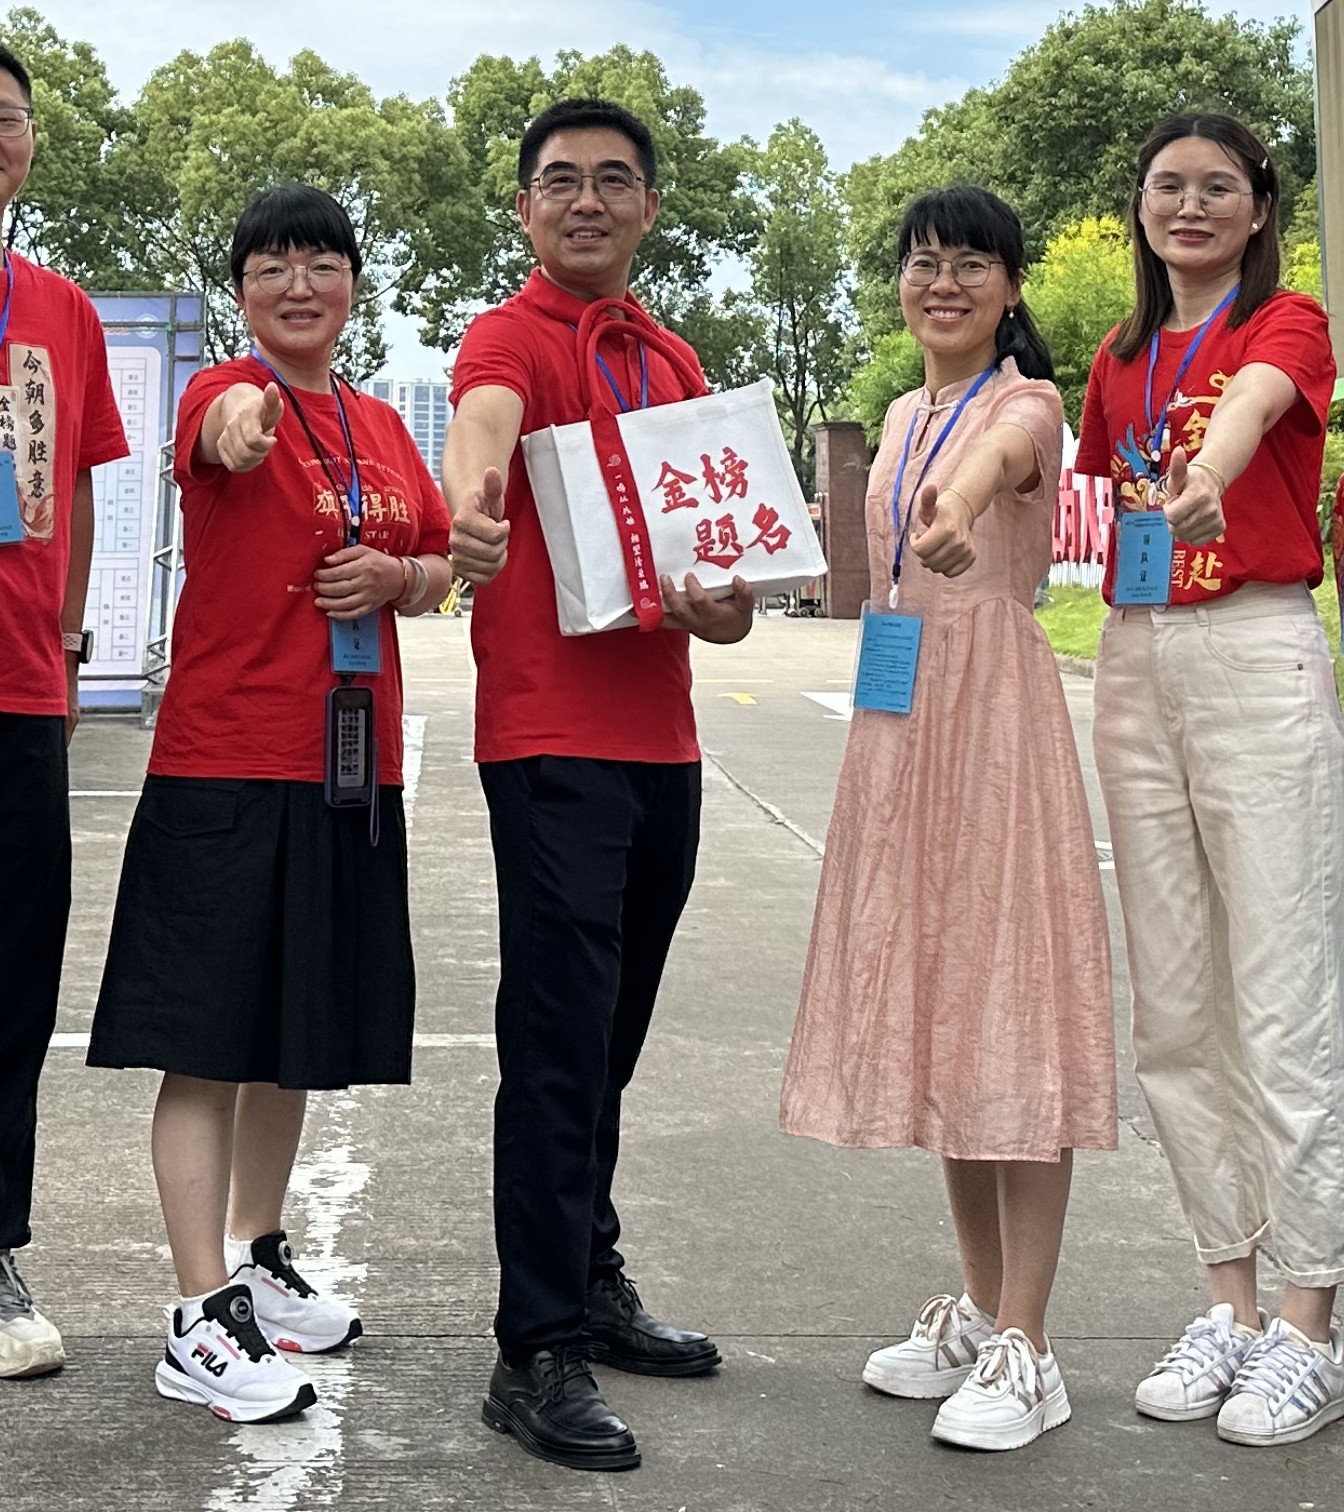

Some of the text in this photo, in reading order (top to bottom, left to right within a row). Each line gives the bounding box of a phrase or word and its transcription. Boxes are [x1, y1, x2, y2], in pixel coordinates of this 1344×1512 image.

[22, 349, 49, 500] 今朝多胜意
[651, 446, 750, 514] 金榜
[693, 502, 793, 570] 题名
[1171, 549, 1187, 588] BEST
[191, 1342, 229, 1378] FILA
